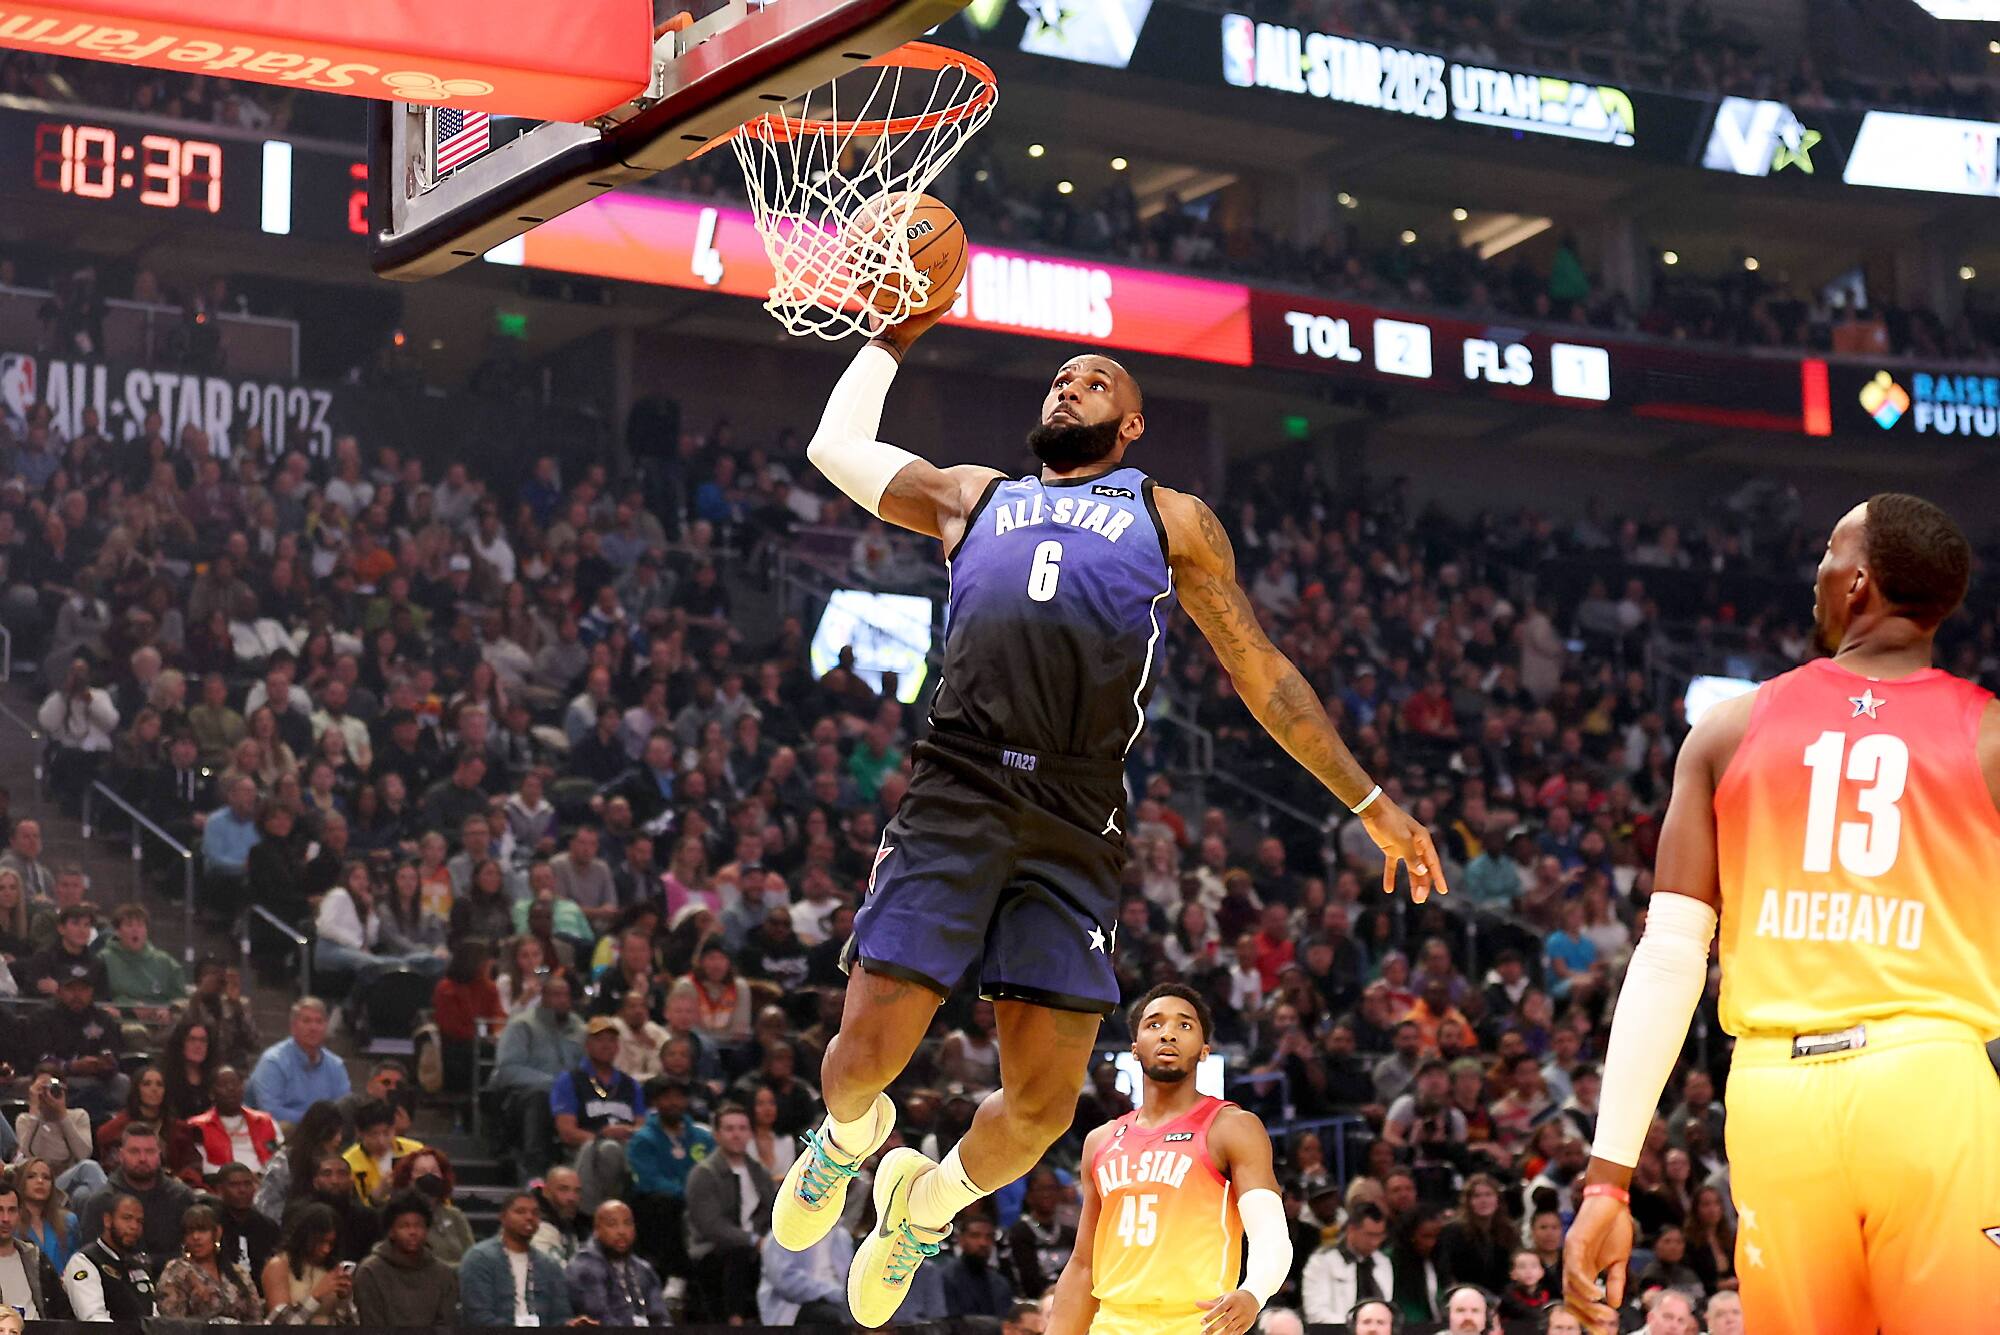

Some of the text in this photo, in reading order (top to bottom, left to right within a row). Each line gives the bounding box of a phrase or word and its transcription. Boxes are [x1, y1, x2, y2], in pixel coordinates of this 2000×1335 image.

[1450, 63, 1542, 121] UTAH
[60, 124, 222, 213] 10:37
[1284, 311, 1362, 362] TOL
[1463, 337, 1533, 386] FLS
[1912, 372, 1999, 408] RAISE
[1914, 401, 2000, 437] FUTU
[1027, 540, 1063, 602] 6
[1002, 750, 1036, 771] UTA23
[1803, 730, 1909, 877] 13
[1755, 887, 1926, 951] ADEBAYO
[1117, 1194, 1160, 1248] 45
